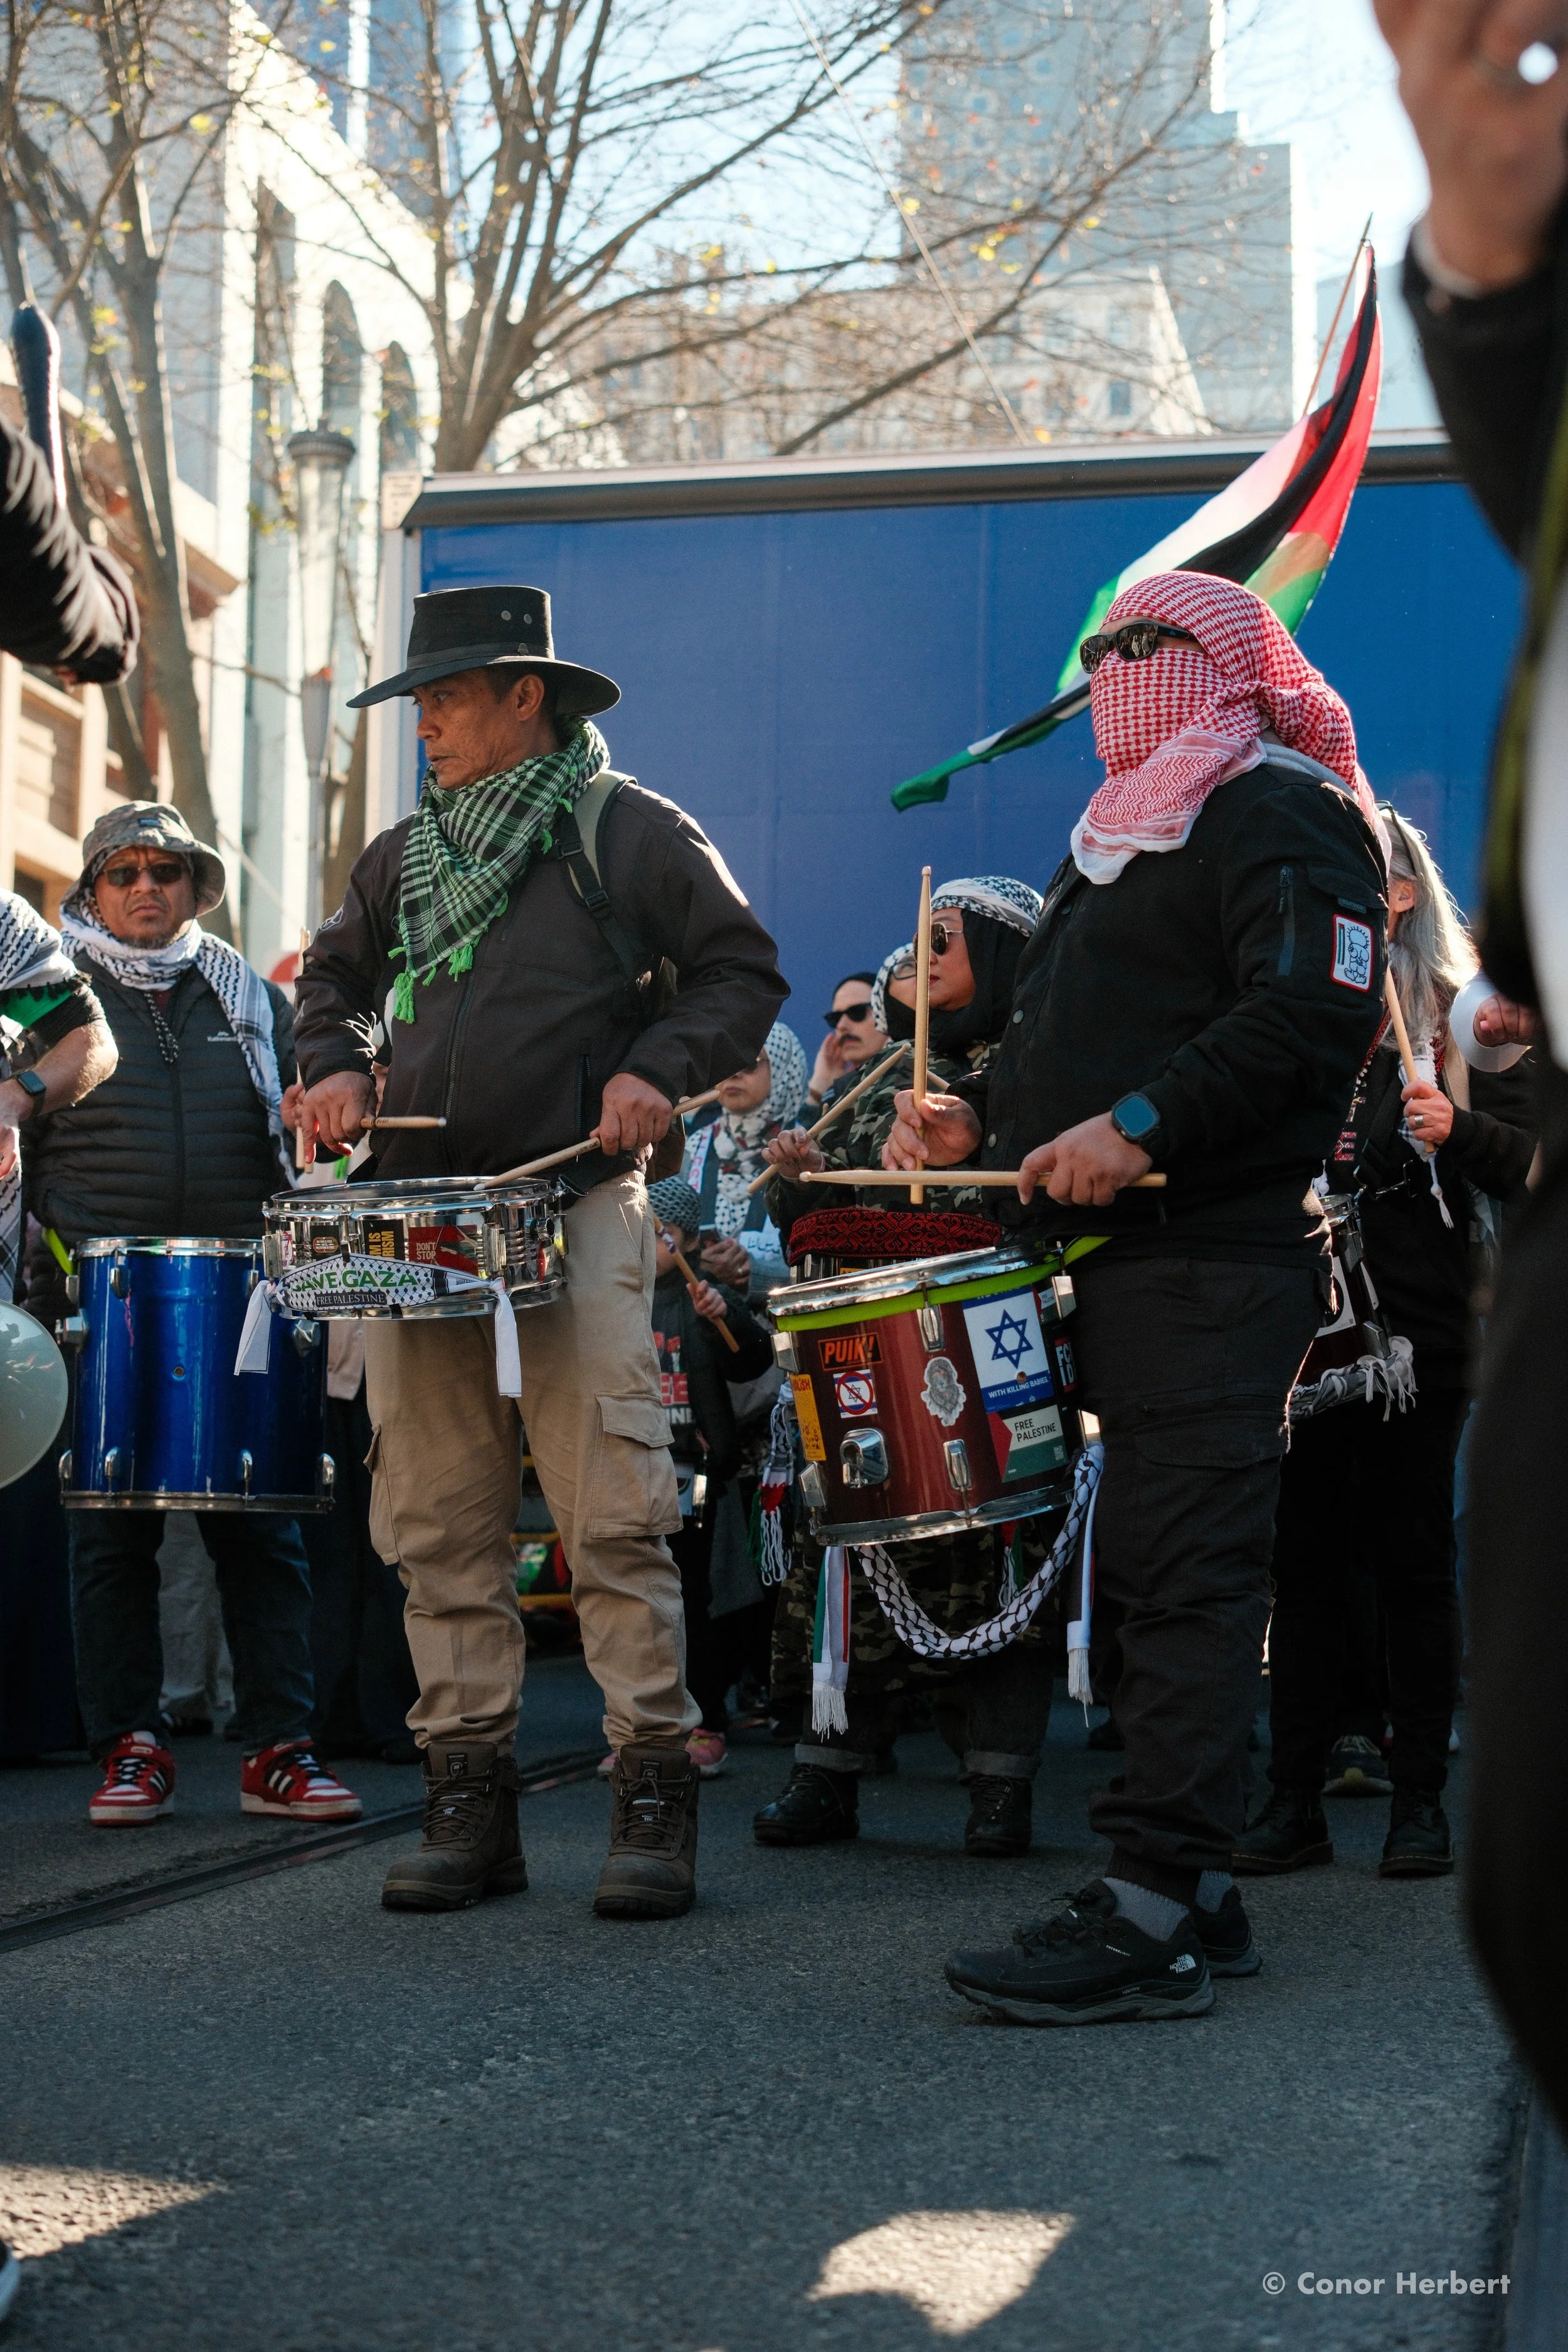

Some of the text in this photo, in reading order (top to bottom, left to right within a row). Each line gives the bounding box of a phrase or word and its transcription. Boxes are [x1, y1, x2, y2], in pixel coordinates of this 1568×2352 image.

[368, 1232, 381, 1242] IS
[381, 1231, 395, 1258] RISM
[416, 1242, 437, 1251] DON'T
[416, 1251, 437, 1260] STOP
[342, 1270, 418, 1288] GAZA
[317, 1294, 385, 1305] FREE PALESTINE
[988, 1389, 1006, 1399] WITH
[1006, 1382, 1029, 1394] KILLING
[1014, 1418, 1034, 1431] FREE
[1017, 1422, 1057, 1442] PALESTINE
[1169, 1960, 1187, 1971] NORTH
[1175, 1965, 1189, 1974] FACE
